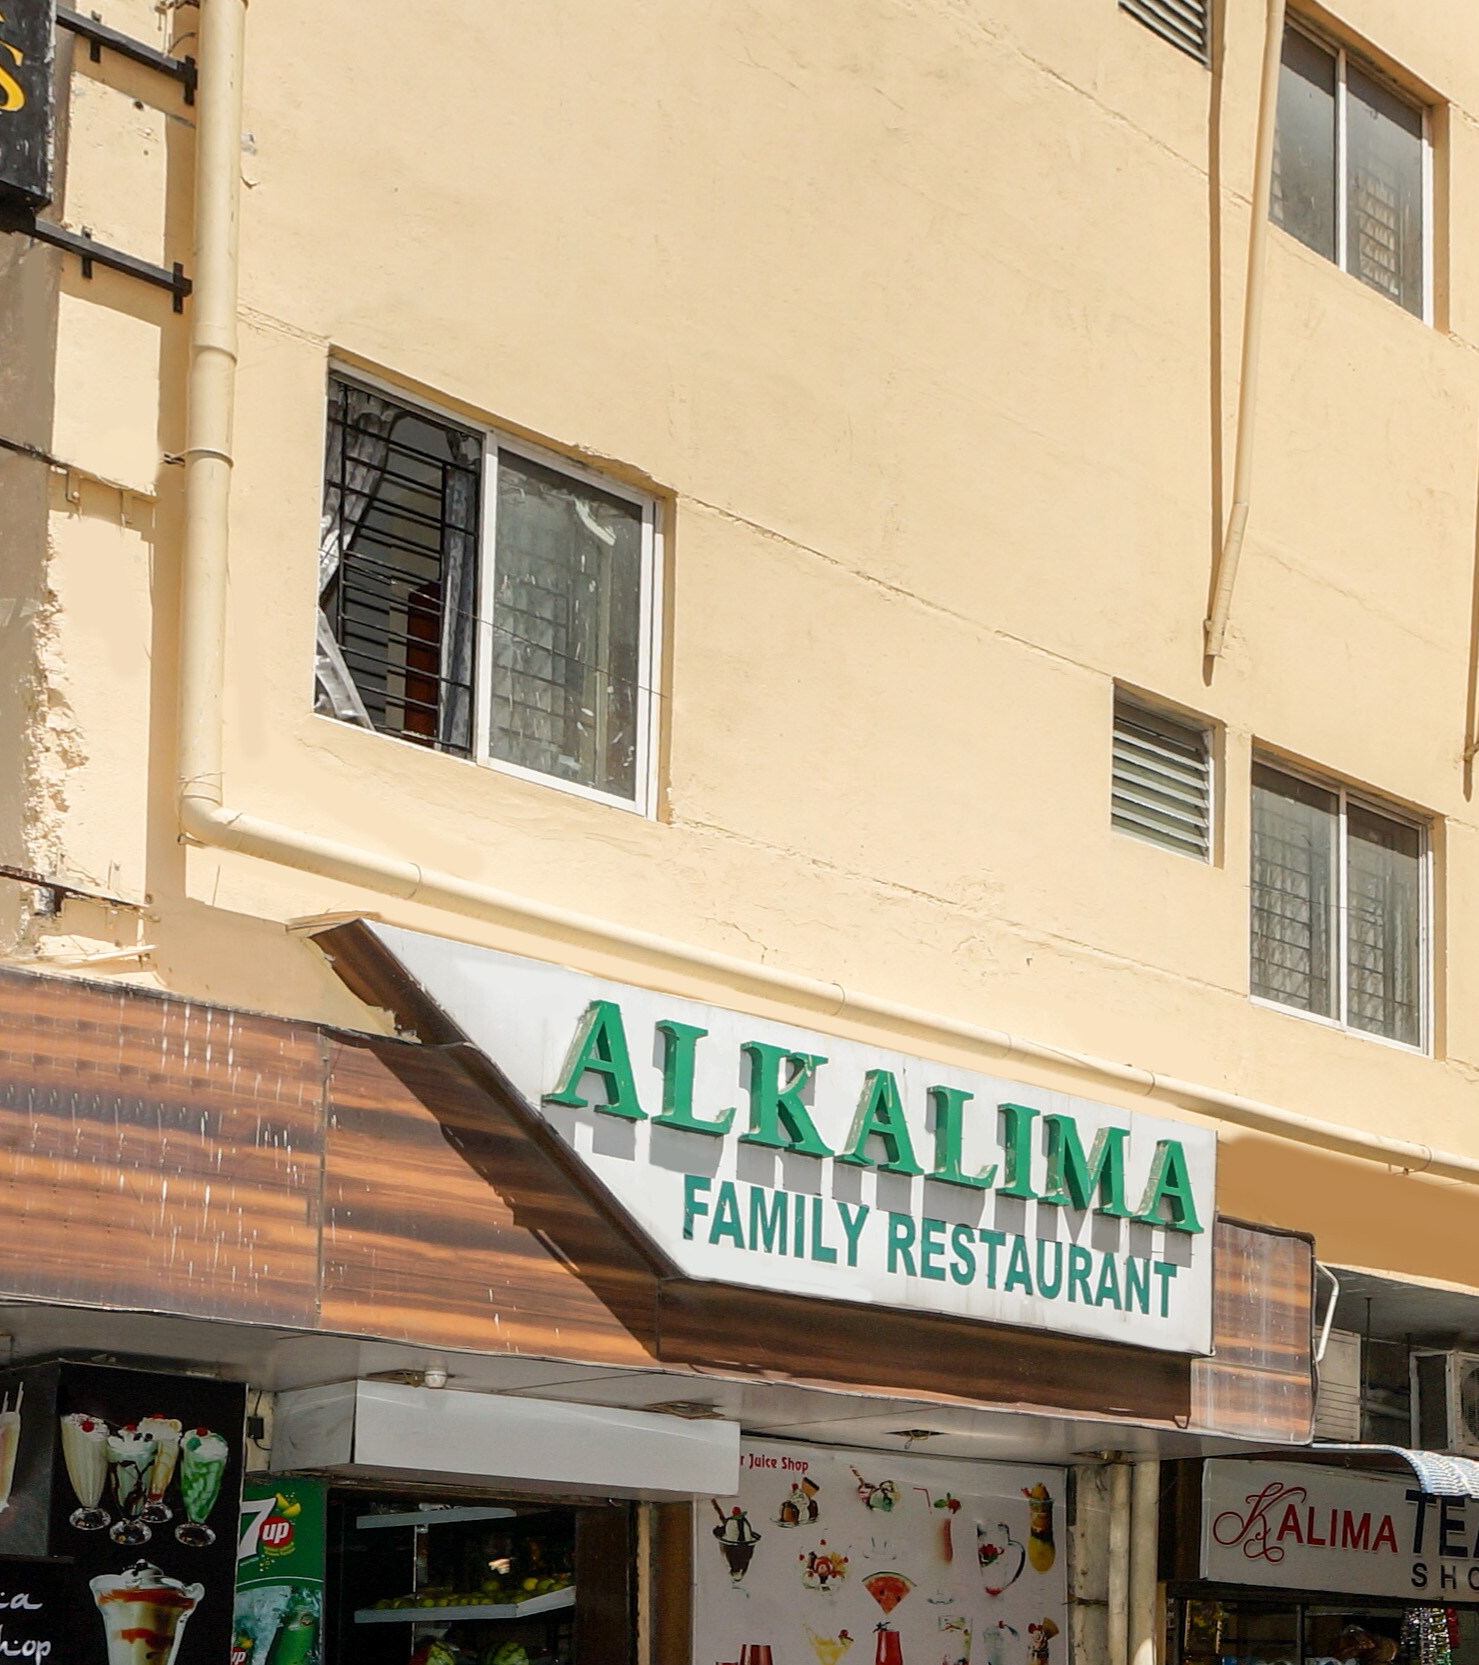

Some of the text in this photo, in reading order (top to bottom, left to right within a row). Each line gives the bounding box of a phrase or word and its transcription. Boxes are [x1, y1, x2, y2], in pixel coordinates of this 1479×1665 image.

[541, 998, 1207, 1236] ALKALIMA
[681, 1173, 1179, 1321] FAMILY RESTAURANT
[749, 1453, 778, 1469] Juice
[781, 1456, 809, 1474] Shop
